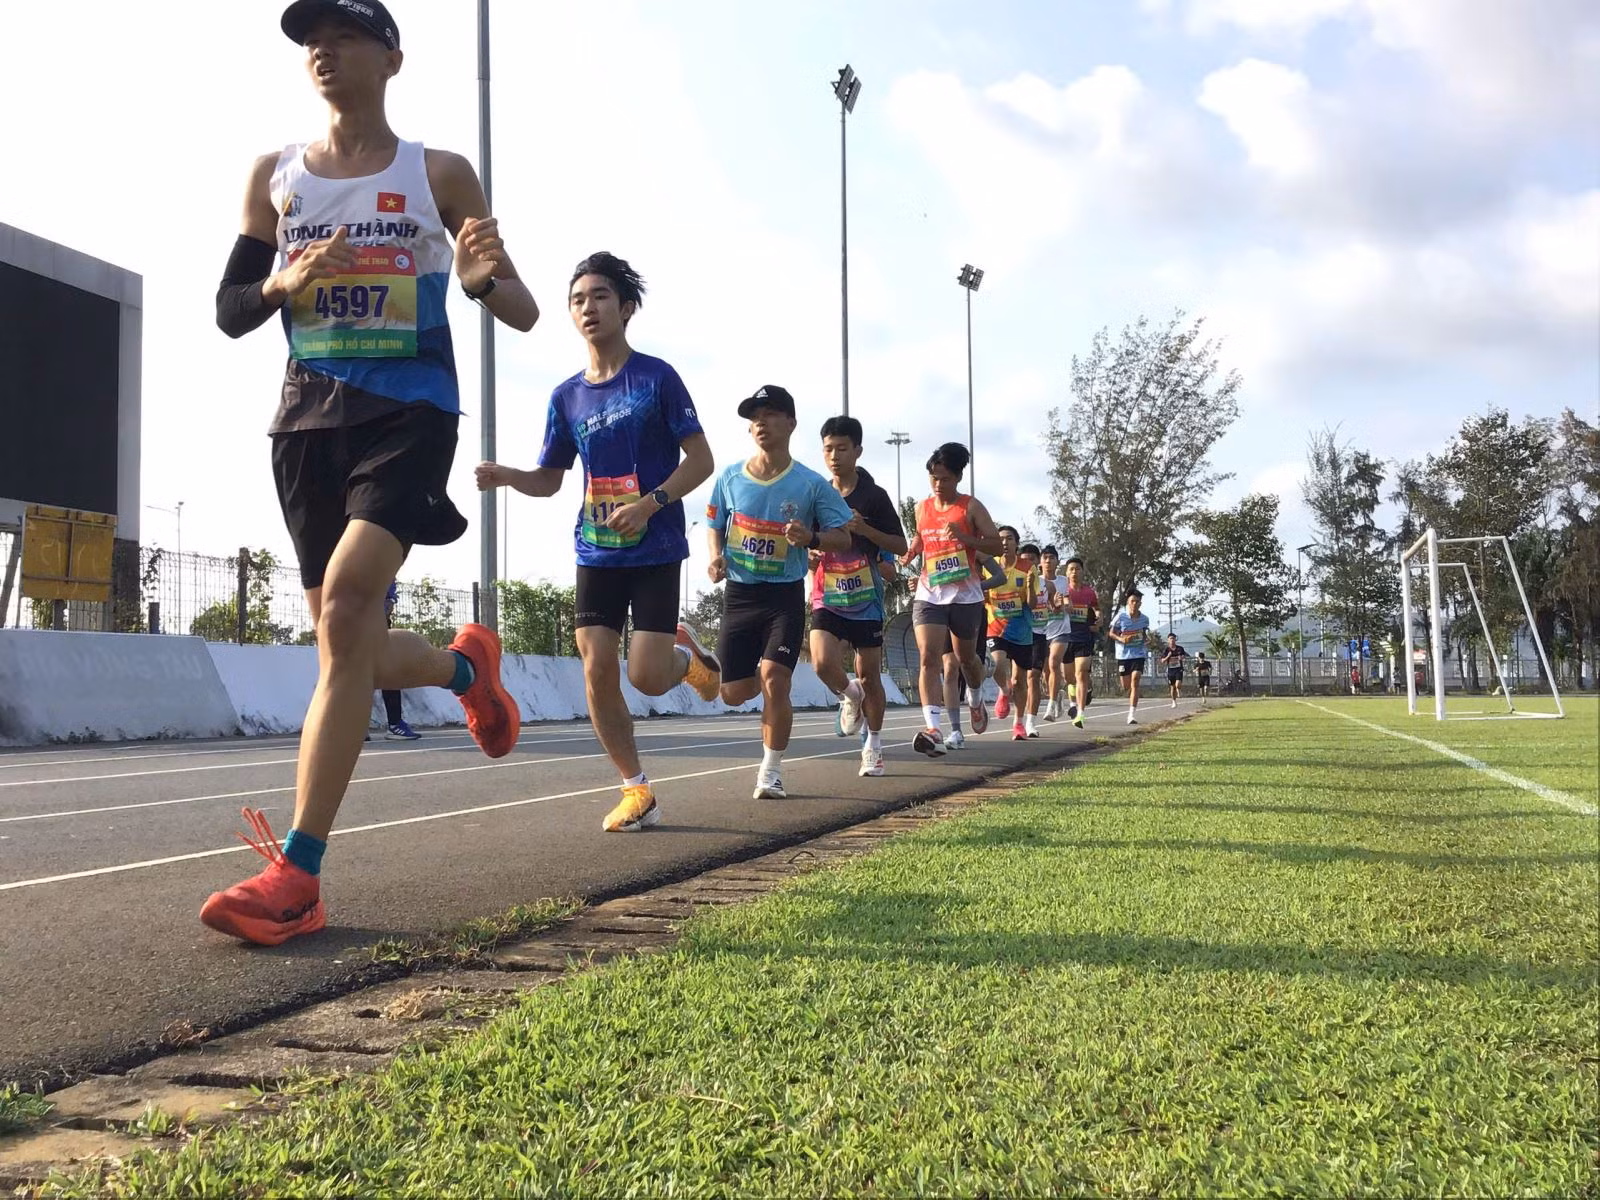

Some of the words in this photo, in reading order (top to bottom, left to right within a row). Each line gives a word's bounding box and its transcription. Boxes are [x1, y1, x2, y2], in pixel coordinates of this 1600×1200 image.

[283, 224, 332, 243] LONG
[341, 219, 419, 239] THÀNH
[315, 285, 389, 319] 4597
[587, 410, 607, 427] HALF
[588, 407, 632, 434] MAATHON
[591, 501, 626, 522] 41
[742, 535, 776, 556] 4626
[935, 556, 960, 572] 4590
[836, 575, 862, 591] 4606
